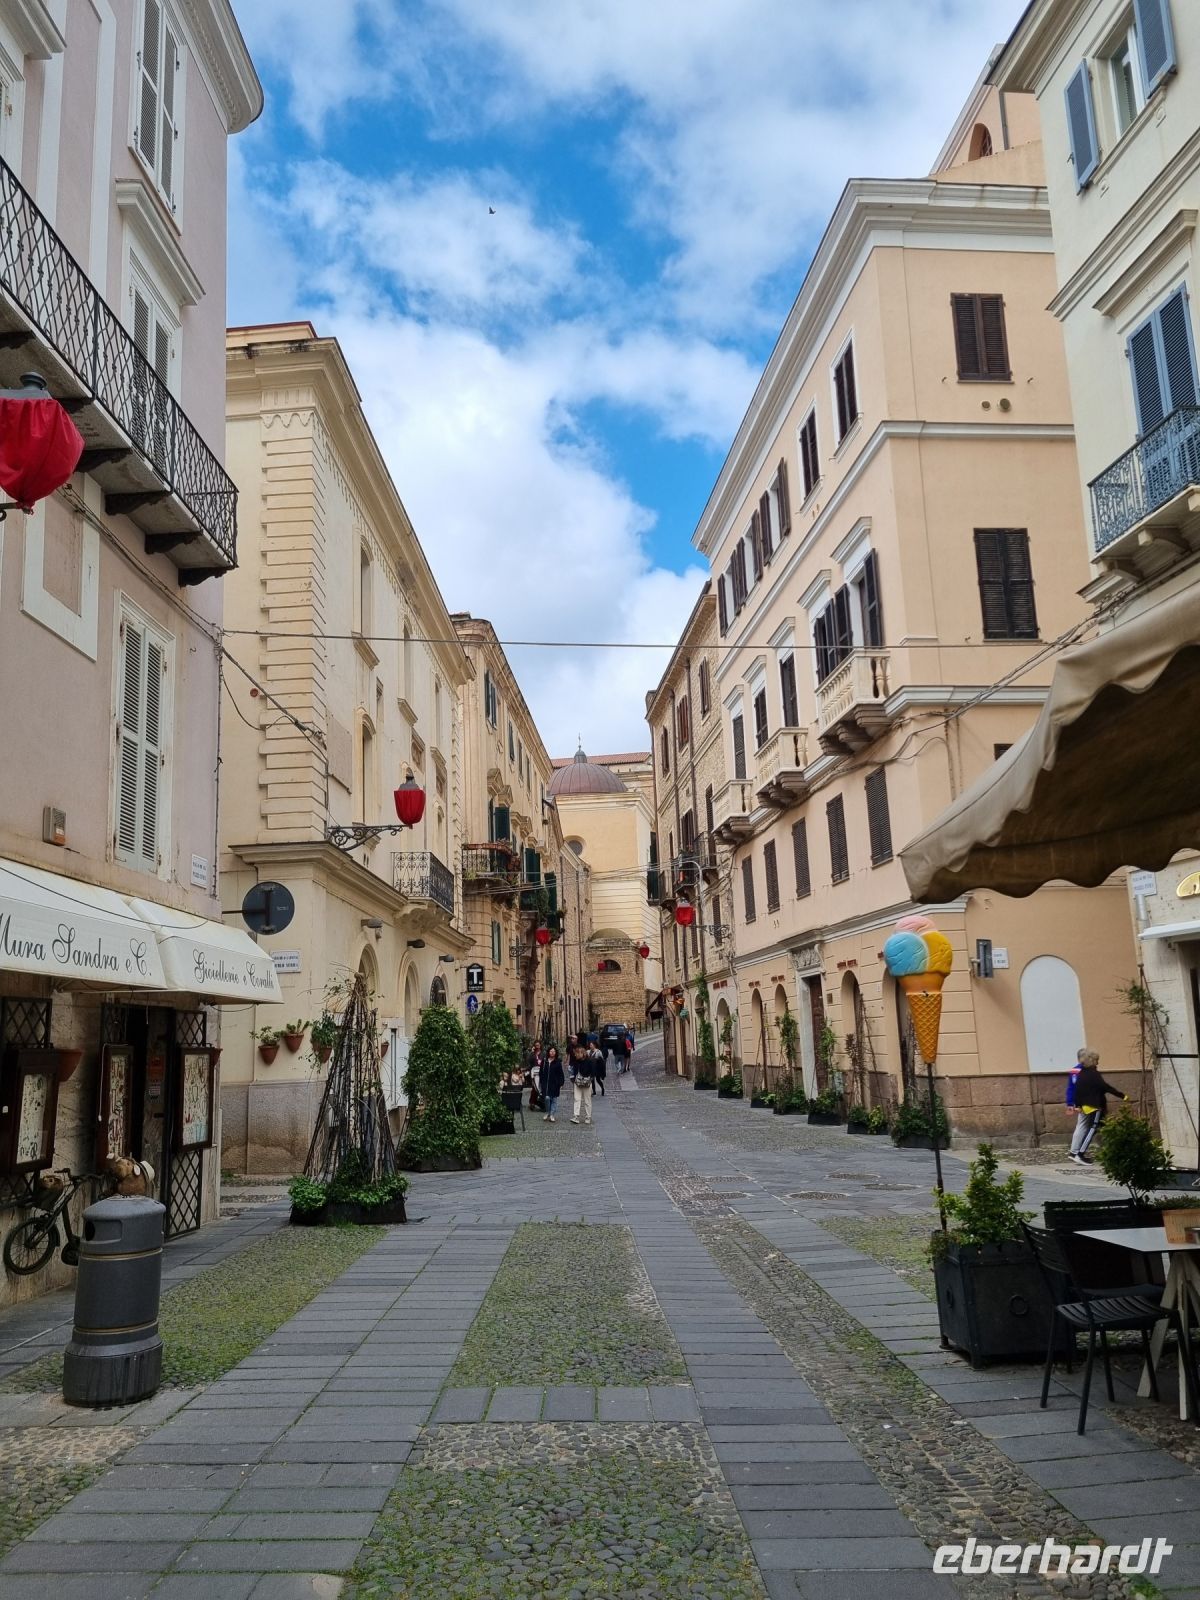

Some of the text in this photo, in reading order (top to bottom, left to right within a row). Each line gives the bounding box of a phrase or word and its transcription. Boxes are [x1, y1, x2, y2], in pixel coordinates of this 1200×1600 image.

[52, 923, 119, 972] Sandra
[125, 958, 133, 974] e
[246, 961, 275, 989] Coralli
[469, 968, 482, 985] T
